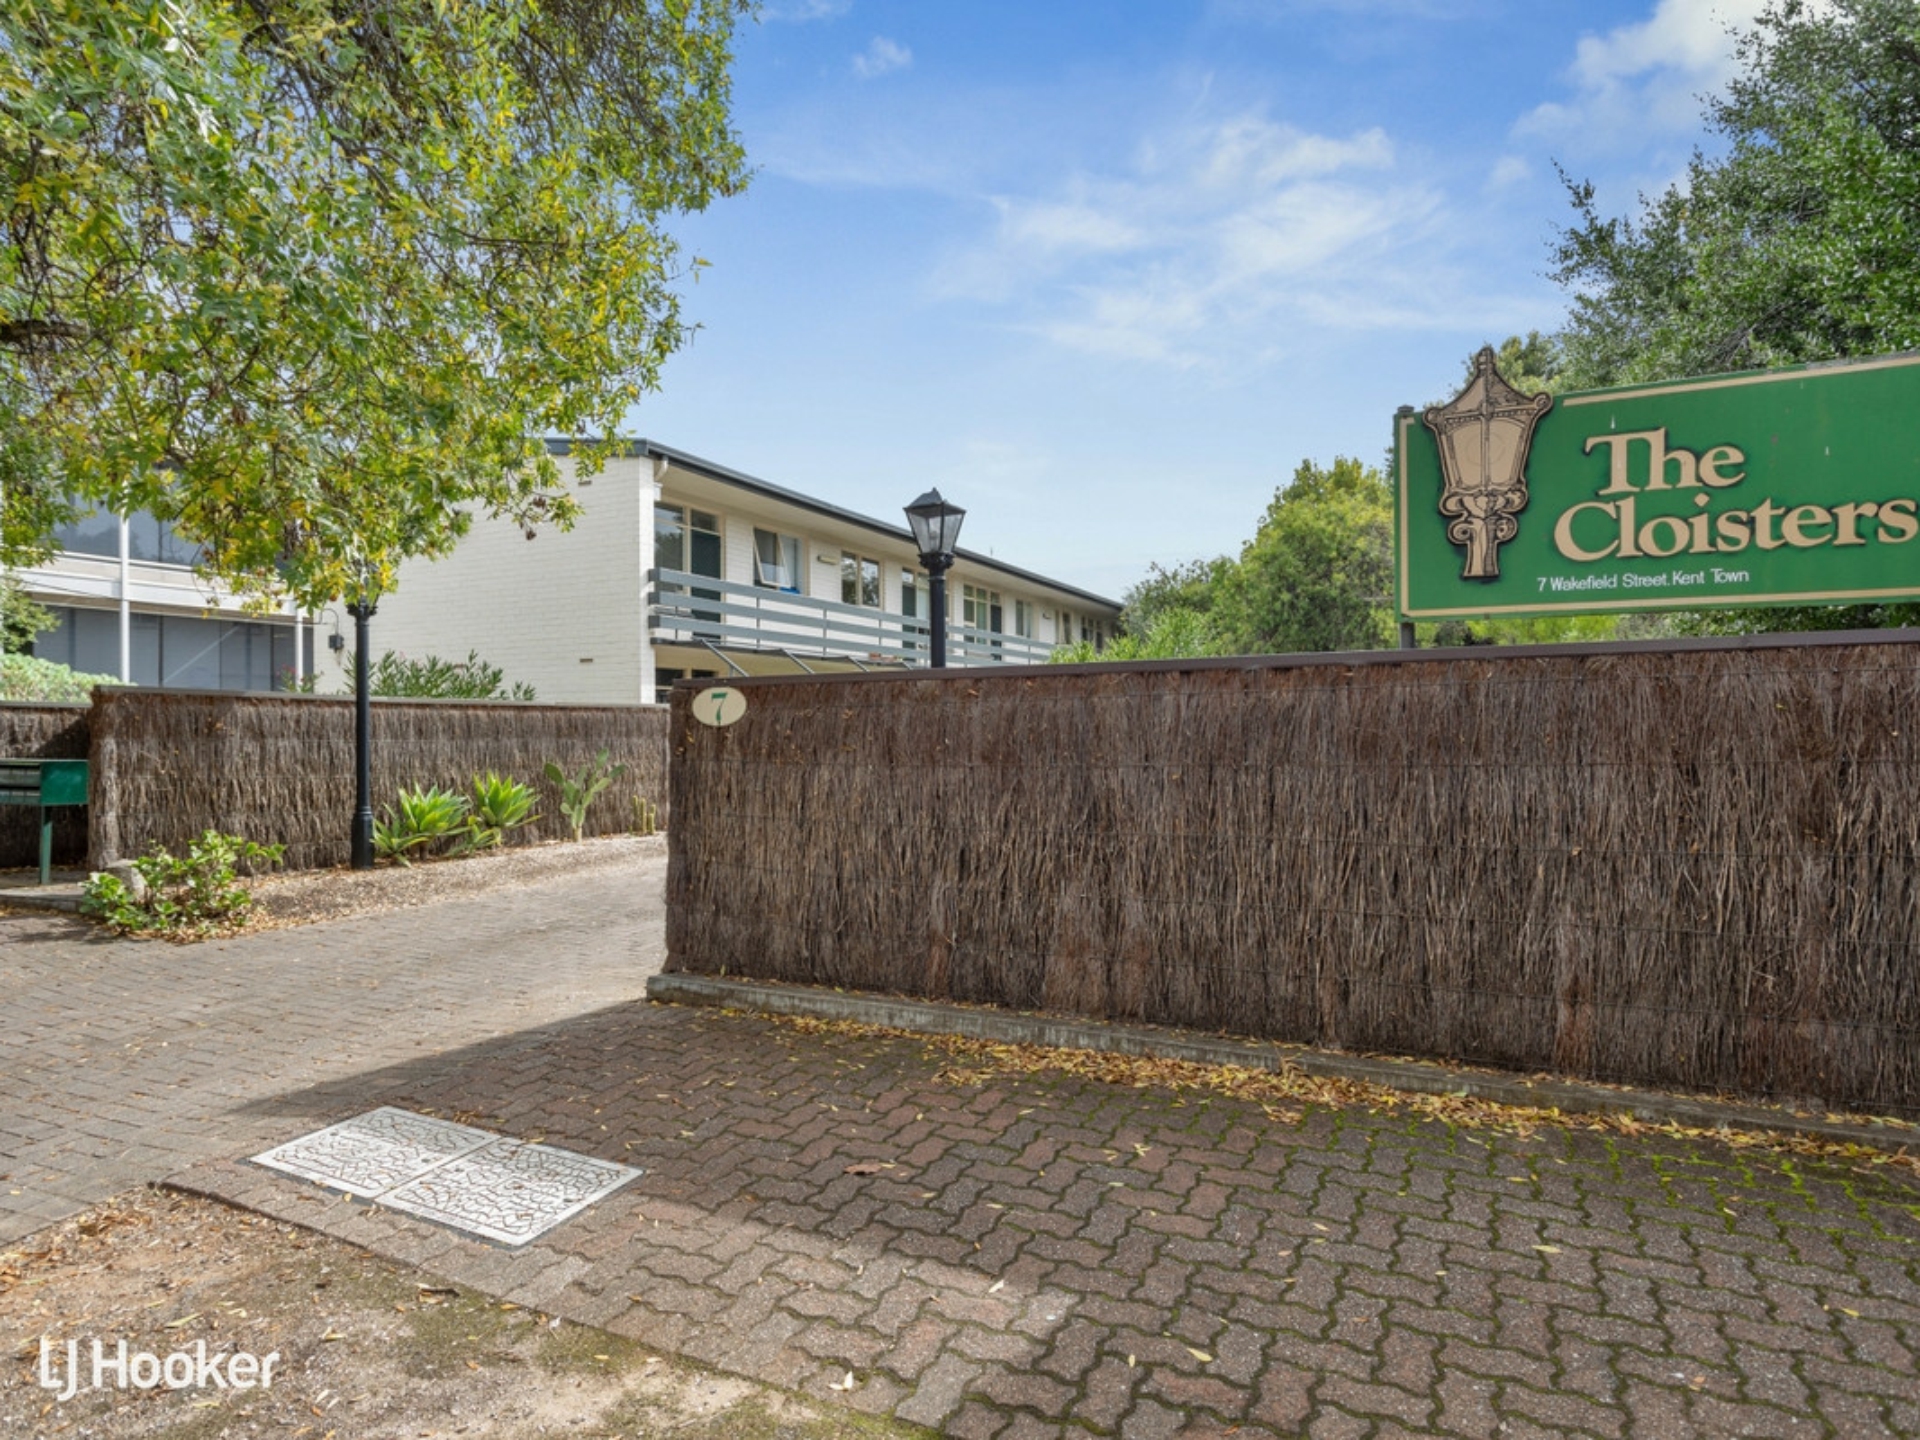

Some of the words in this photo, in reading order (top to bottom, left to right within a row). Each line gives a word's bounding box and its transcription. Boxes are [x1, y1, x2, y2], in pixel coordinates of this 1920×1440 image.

[1584, 428, 1745, 495] The
[1554, 494, 1919, 561] Cloisters
[1537, 577, 1547, 592] 7
[1550, 574, 1617, 591] Wakefield
[1672, 570, 1705, 586] Kent
[1710, 568, 1749, 583] Town
[711, 692, 728, 724] 7
